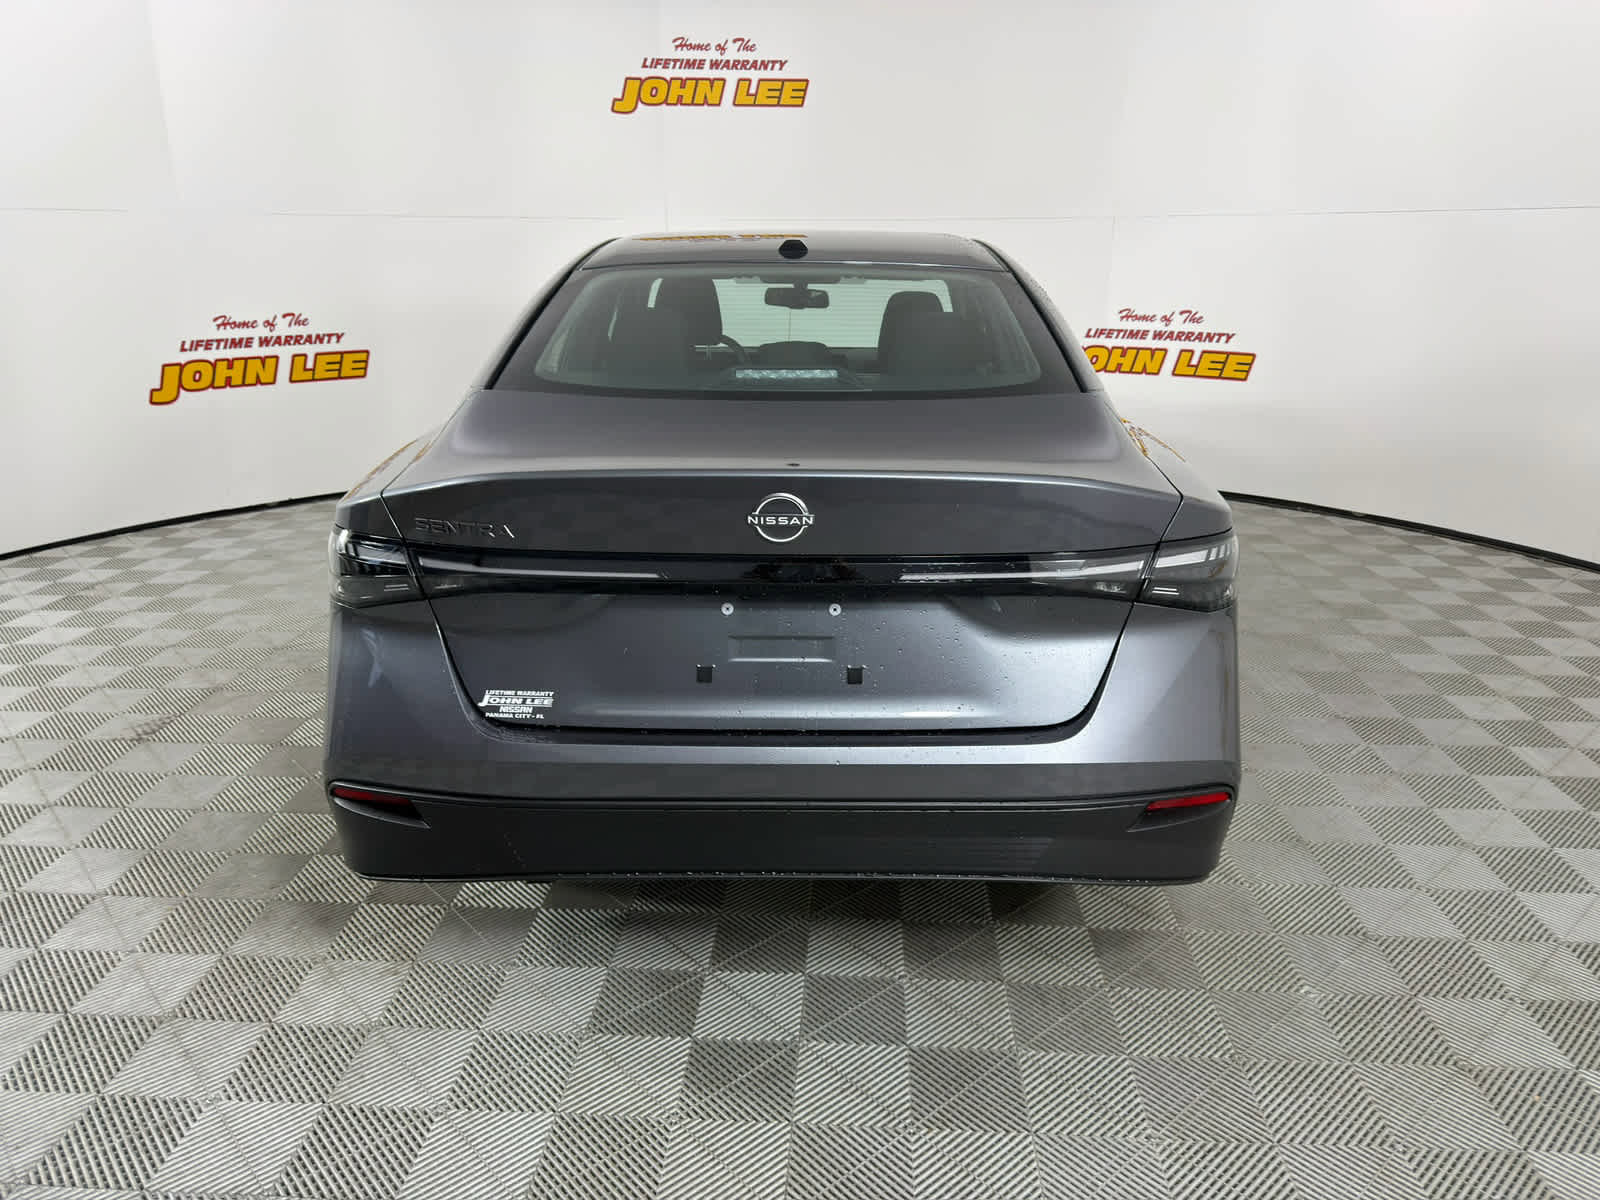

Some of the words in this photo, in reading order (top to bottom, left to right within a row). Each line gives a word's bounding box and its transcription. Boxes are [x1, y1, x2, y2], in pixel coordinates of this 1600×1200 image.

[672, 36, 711, 52] Home
[714, 39, 729, 56] of
[732, 37, 757, 53] The
[641, 57, 706, 70] LIFETIME
[709, 59, 788, 71] WARRANTY
[611, 76, 726, 114] JOHN
[733, 78, 809, 107] LEE
[213, 314, 258, 331] Home
[263, 315, 278, 333] of
[281, 312, 310, 329] The
[1118, 308, 1157, 323] Home
[1160, 311, 1175, 326] of
[1179, 309, 1204, 324] The
[179, 336, 254, 353] LIFETIME
[257, 332, 345, 348] WARRANTY
[1084, 328, 1150, 341] LIFETIME
[1151, 330, 1236, 344] WARRANTY
[1083, 345, 1168, 375] OHN
[1172, 349, 1256, 381] LEE
[149, 355, 279, 405] JOHN
[289, 349, 370, 383] LEE
[413, 516, 516, 539] SENTRA
[747, 515, 814, 525] NISSAN
[478, 694, 523, 707] JOHN
[525, 698, 554, 706] LEE
